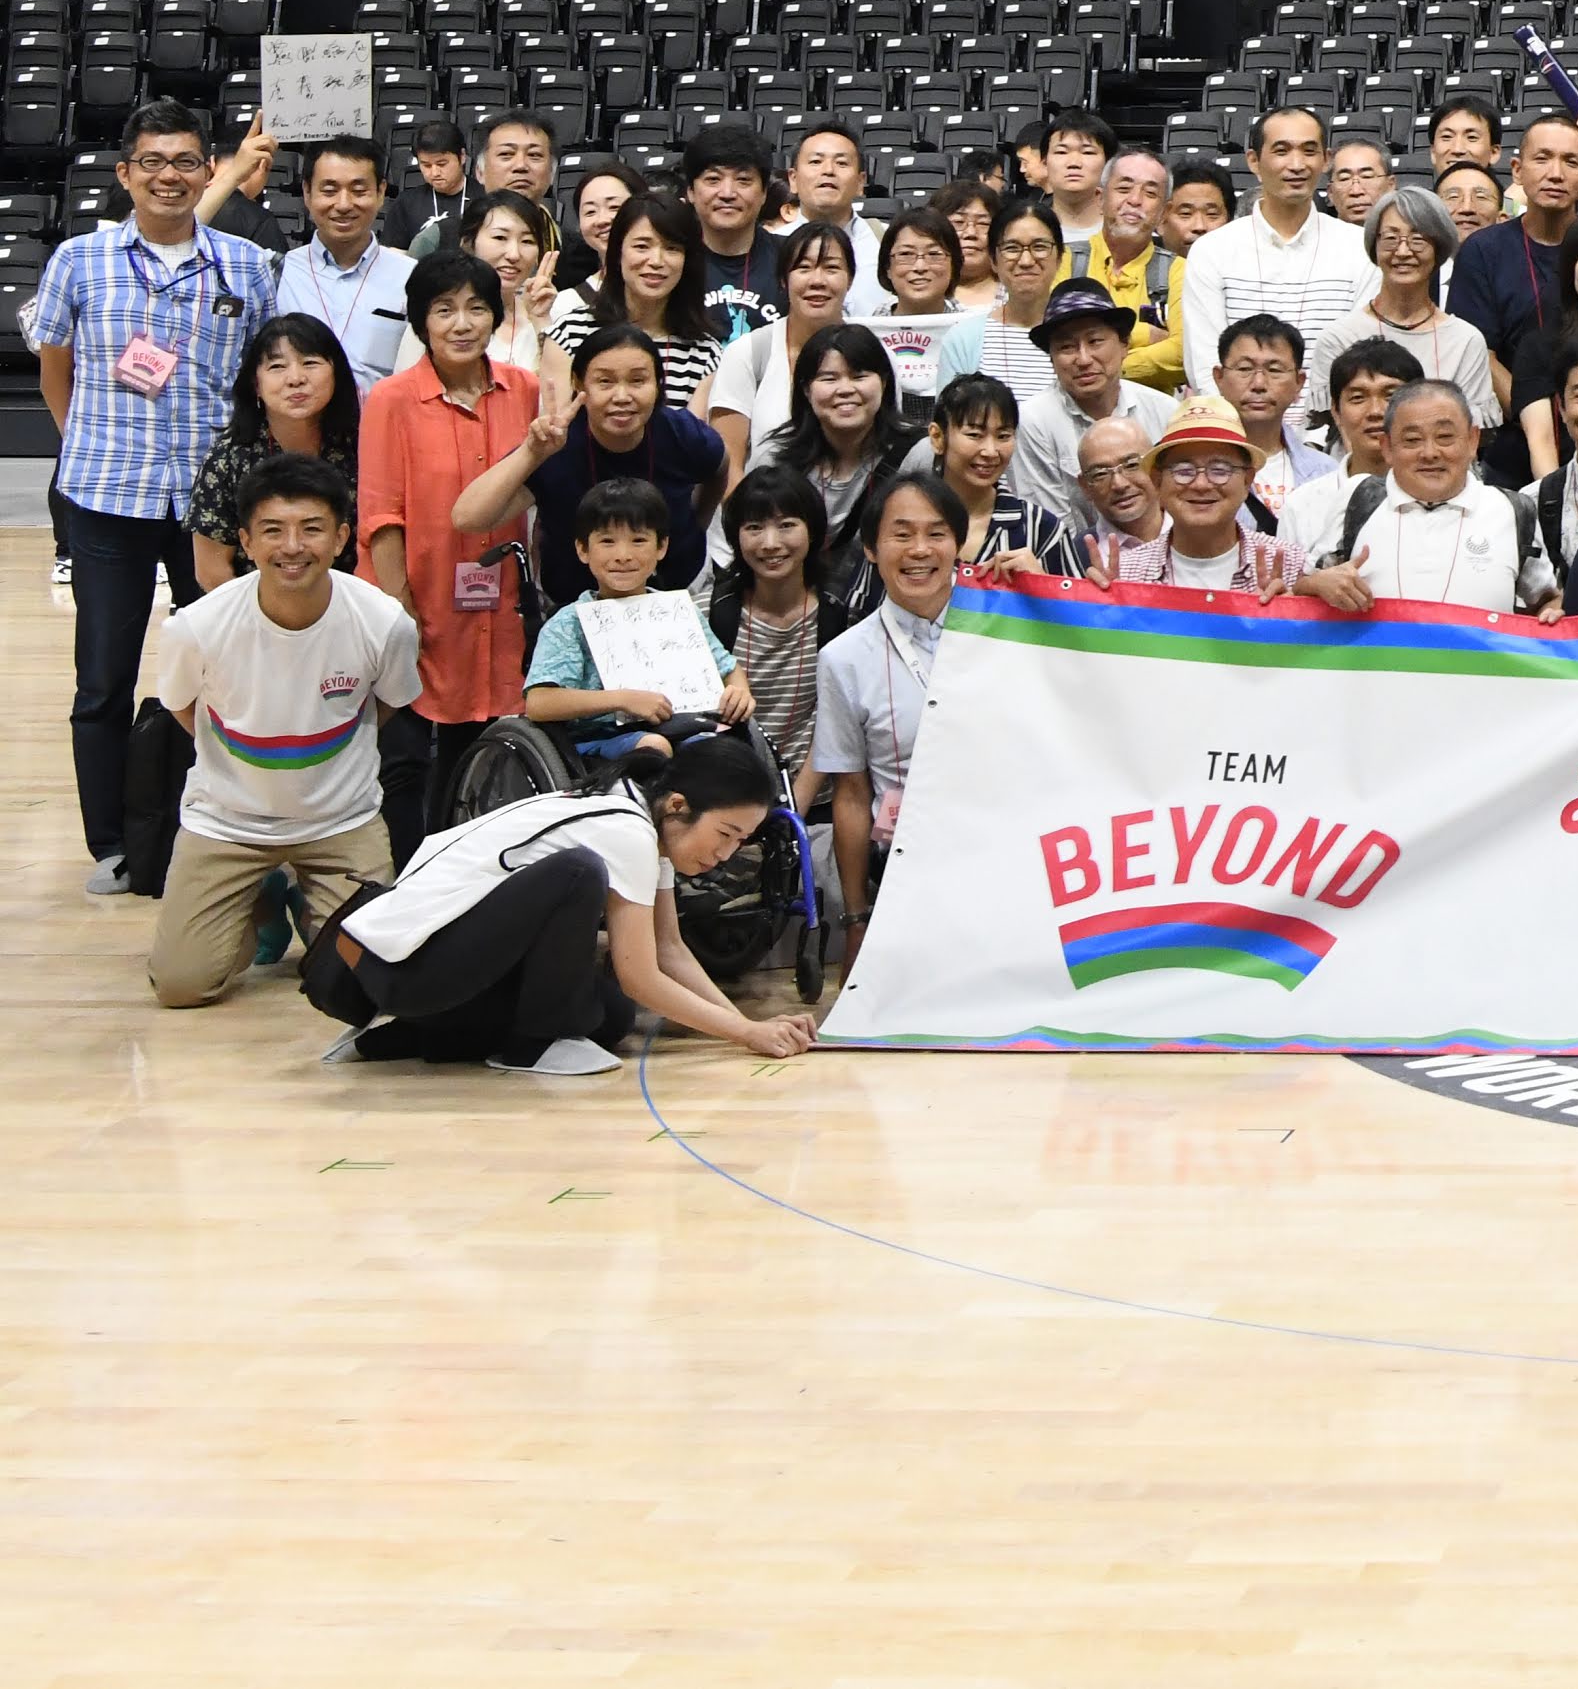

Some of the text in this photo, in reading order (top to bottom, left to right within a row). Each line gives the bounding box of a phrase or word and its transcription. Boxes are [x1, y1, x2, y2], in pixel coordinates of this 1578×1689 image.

[704, 289, 761, 310] WHEEL
[882, 331, 932, 348] BEYOND
[132, 352, 166, 373] BEYOND
[320, 676, 360, 694] BEYOND
[1207, 750, 1288, 785] TEAM
[1038, 803, 1402, 910] BEYOND
